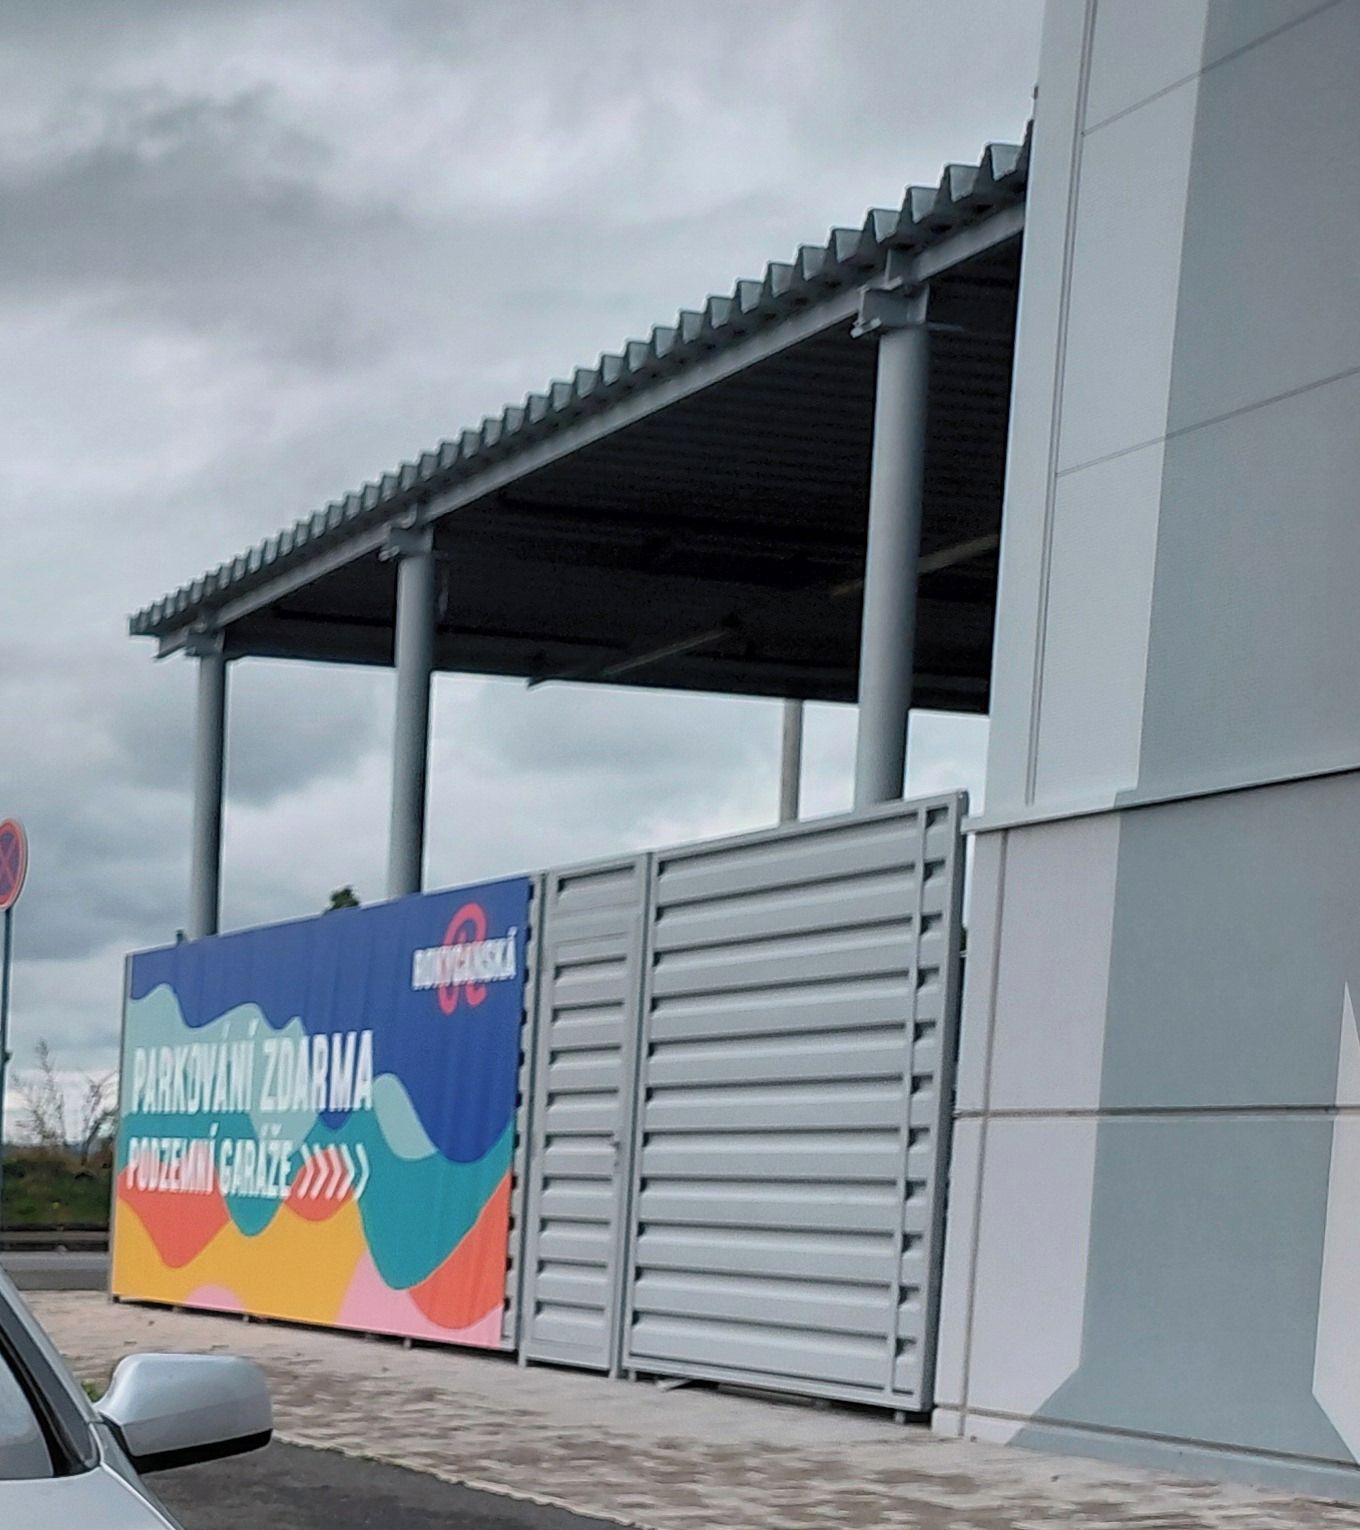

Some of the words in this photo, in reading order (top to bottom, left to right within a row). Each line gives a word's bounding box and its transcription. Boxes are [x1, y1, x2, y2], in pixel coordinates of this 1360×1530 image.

[131, 1017, 260, 1115] PARKOVÁNÍ
[259, 1029, 373, 1112] ZDARMA
[126, 1122, 220, 1195] PODZEMNÍ
[218, 1122, 294, 1199] GARÁŽE
